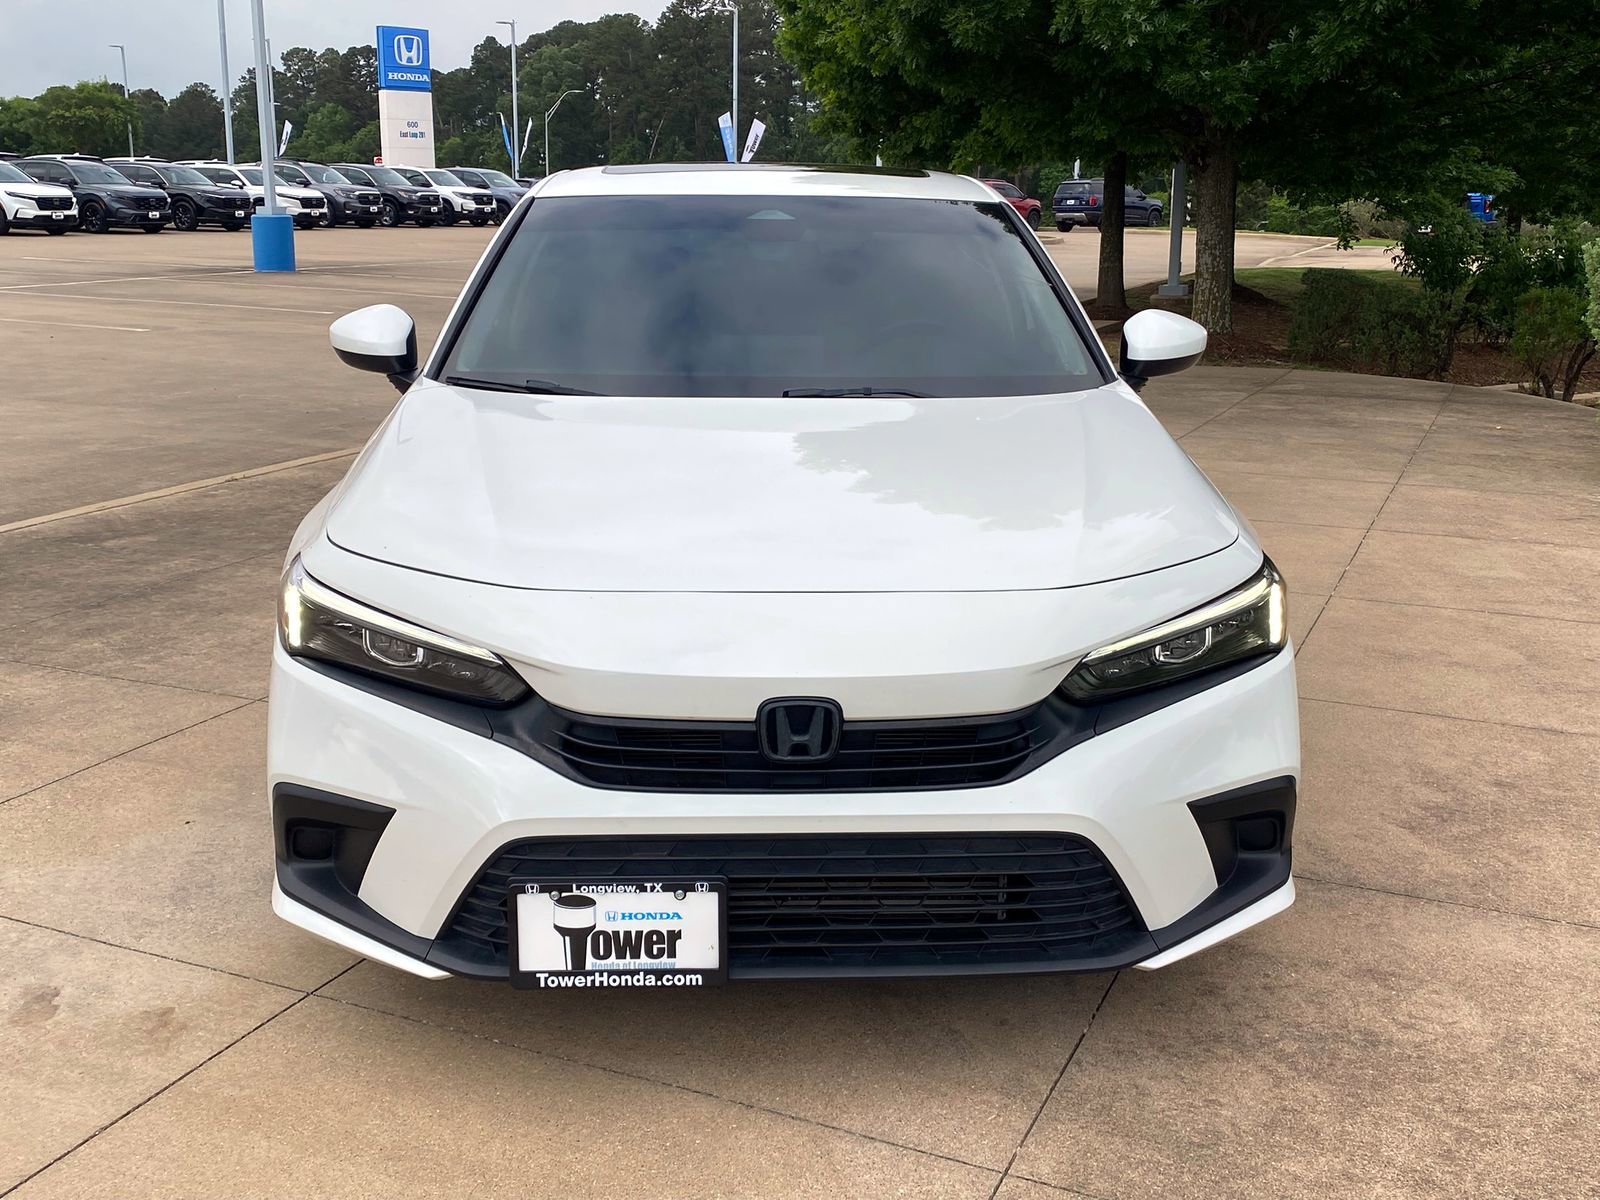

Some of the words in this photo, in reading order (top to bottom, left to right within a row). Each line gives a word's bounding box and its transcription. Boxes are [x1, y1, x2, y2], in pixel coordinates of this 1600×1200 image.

[388, 72, 430, 82] HONDA
[573, 884, 640, 894] Longview,
[644, 883, 663, 893] TX
[621, 912, 682, 921] HONDA
[536, 972, 703, 988] TowerHonda.com
